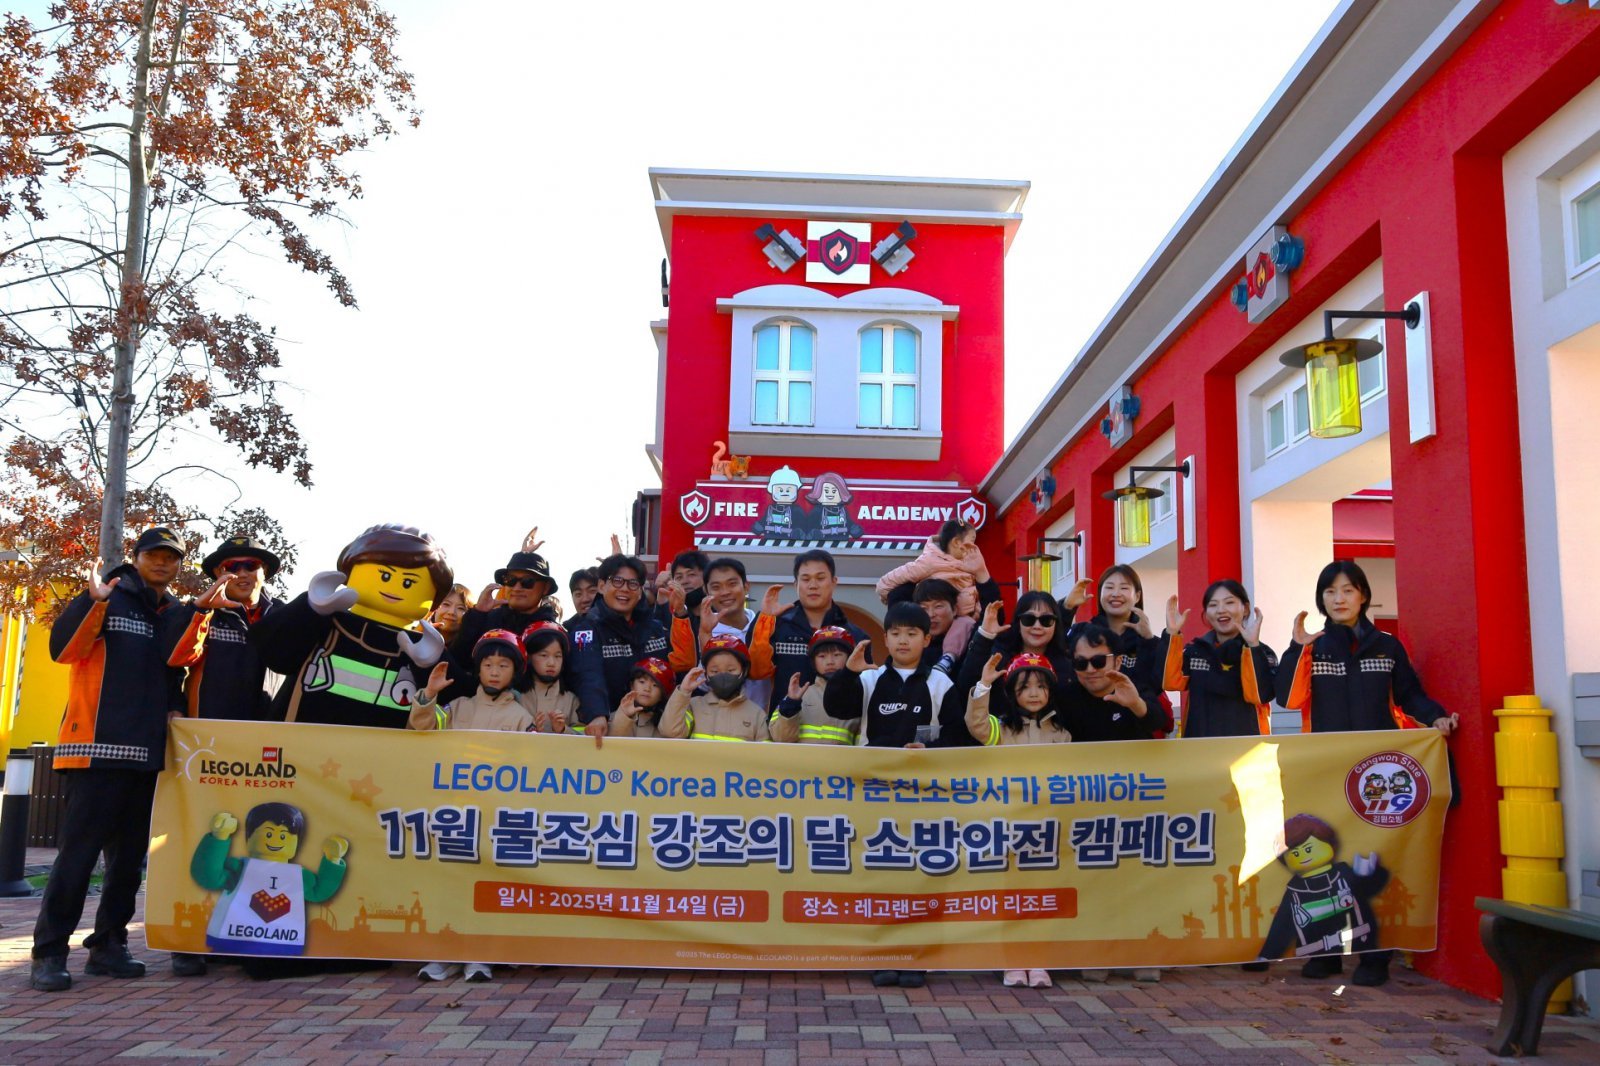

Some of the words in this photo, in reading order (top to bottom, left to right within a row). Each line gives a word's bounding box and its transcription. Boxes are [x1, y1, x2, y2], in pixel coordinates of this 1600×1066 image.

[714, 502, 759, 517] FIRE
[858, 505, 953, 521] ACADEMY
[879, 703, 921, 714] CHICAO
[201, 748, 296, 778] LEGOLAND
[1354, 754, 1398, 774] Gangwon
[1400, 757, 1421, 777] State
[200, 776, 238, 786] KOREA
[245, 779, 295, 789] RESORT
[433, 762, 623, 795] LEGOLAND®
[631, 771, 716, 798] Korea
[725, 772, 856, 801] Resort와
[862, 775, 1039, 805] 춘천소방서가
[1047, 772, 1167, 805] 함께하는
[1365, 794, 1413, 814] 119
[379, 805, 480, 861] 11월
[490, 808, 638, 867] 불조심
[648, 811, 794, 869] 강조의
[804, 815, 855, 871] 달
[862, 816, 1060, 875] 소방안전
[1070, 810, 1216, 867] 캠페인
[269, 876, 278, 890] I
[498, 887, 533, 907] 일시
[550, 891, 613, 912] 2025년
[619, 894, 660, 915] 11월
[666, 895, 707, 916] 14일
[713, 896, 745, 918] (금)
[802, 898, 839, 917] 장소
[854, 897, 938, 919] 레고랜드®
[943, 894, 998, 915] 코리아
[1003, 894, 1058, 914] 리조트
[228, 924, 298, 941] LEGOLAND
[712, 952, 731, 960] LEGO
[850, 954, 900, 962] Entertainments
